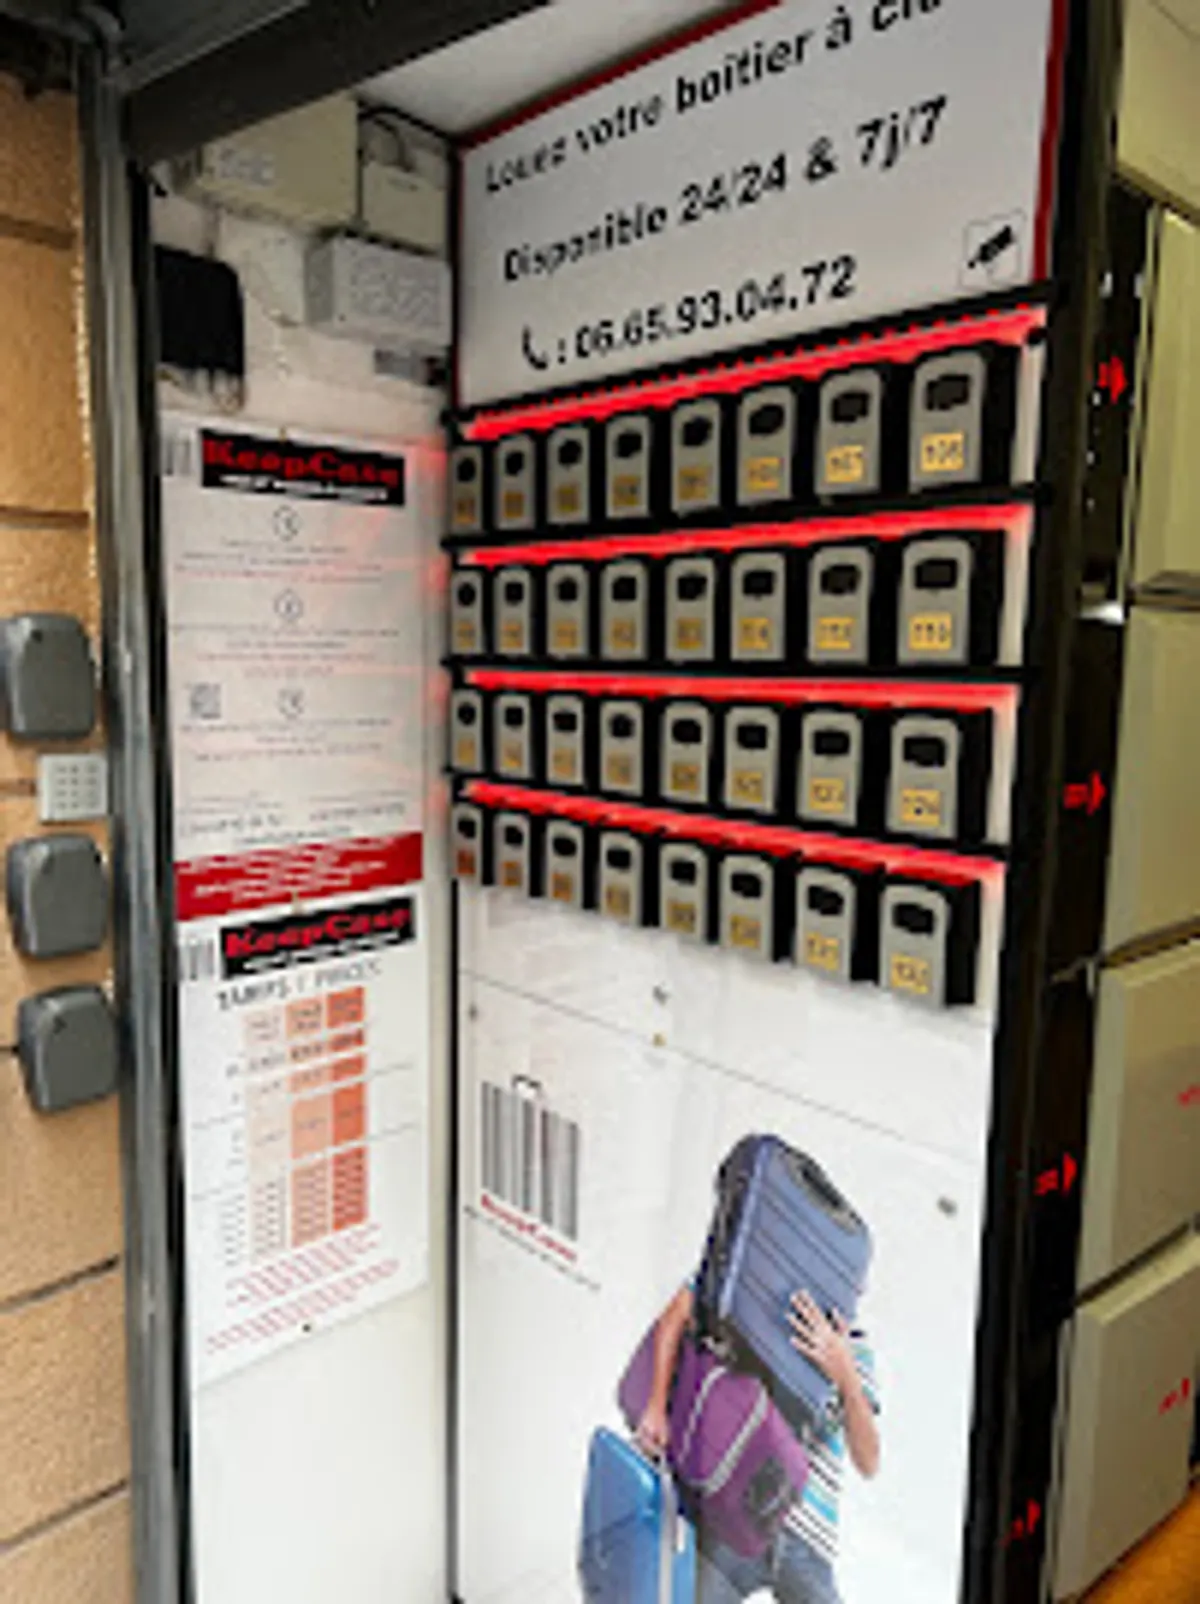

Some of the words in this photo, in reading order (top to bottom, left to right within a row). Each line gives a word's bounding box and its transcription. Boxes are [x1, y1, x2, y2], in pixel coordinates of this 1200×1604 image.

[575, 95, 663, 153] votre
[675, 31, 811, 116] boîtier
[825, 5, 852, 51] à
[503, 201, 668, 282] Disponible
[678, 153, 788, 227] 24/24
[804, 135, 840, 183] &
[856, 94, 948, 170] 7j/7
